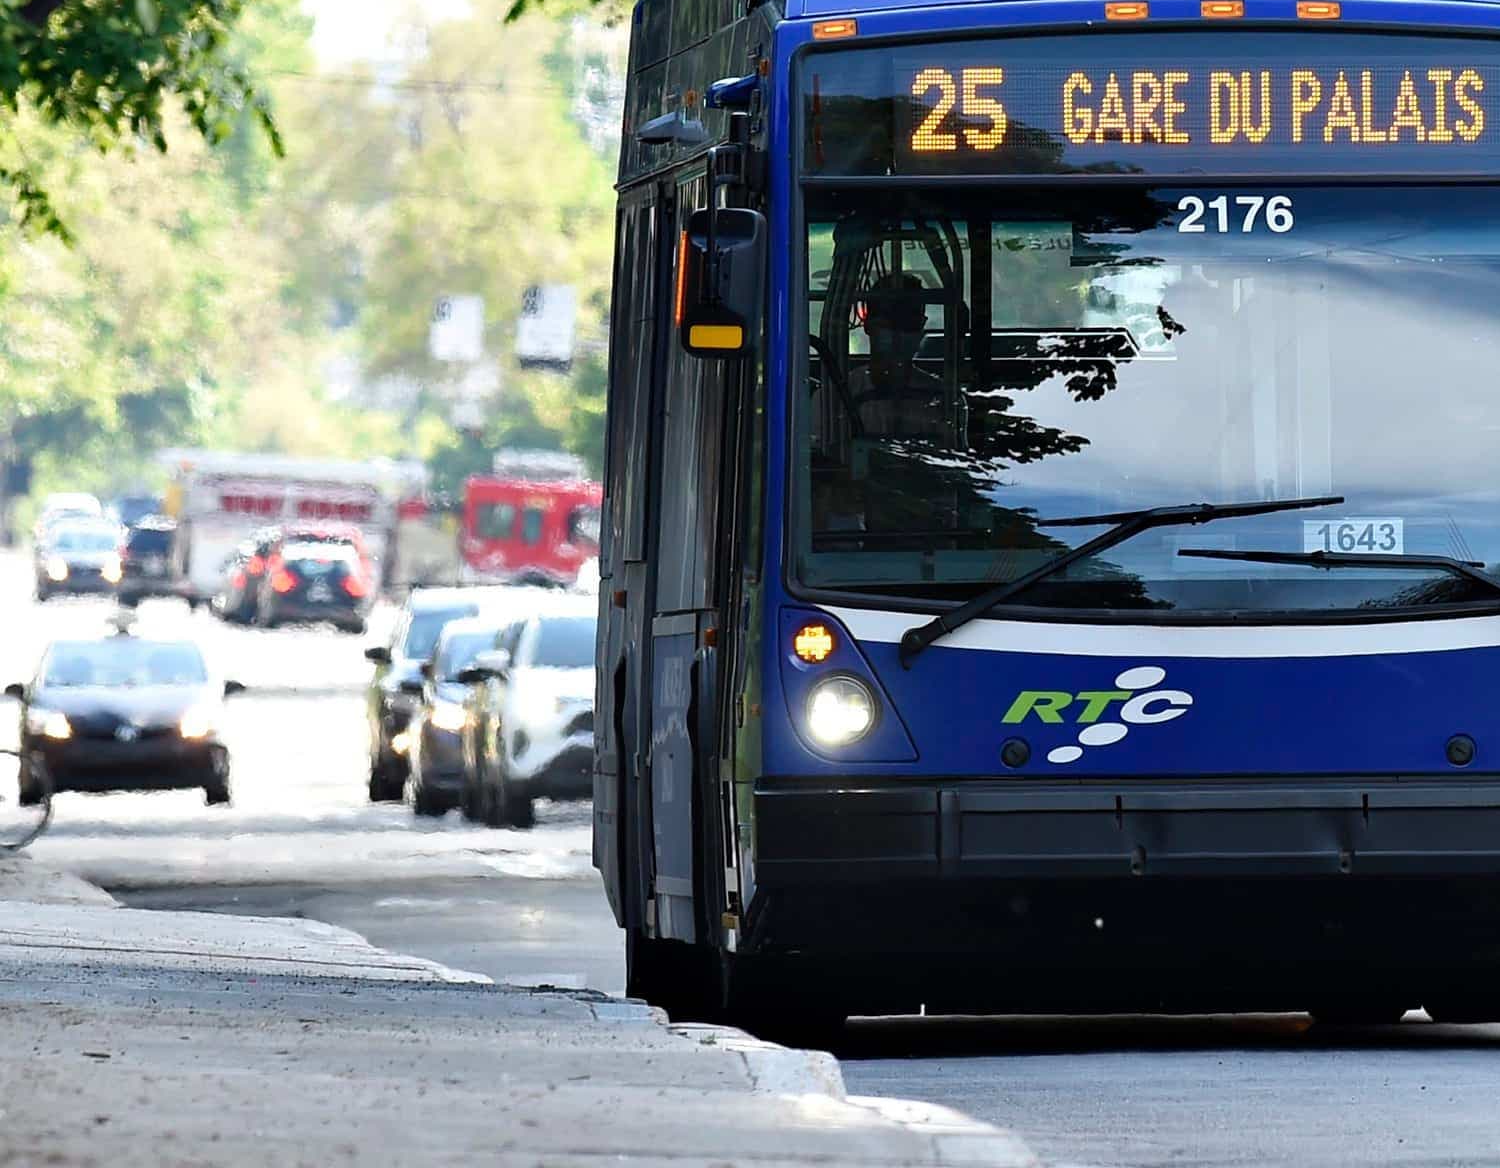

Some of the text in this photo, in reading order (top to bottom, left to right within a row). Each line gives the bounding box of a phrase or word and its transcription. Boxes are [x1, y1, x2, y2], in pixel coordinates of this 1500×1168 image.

[911, 68, 1485, 151] 25 GARE DU PALAIS
[1177, 196, 1294, 233] 2176
[1317, 522, 1397, 553] 1643
[1001, 689, 1194, 725] RTC
